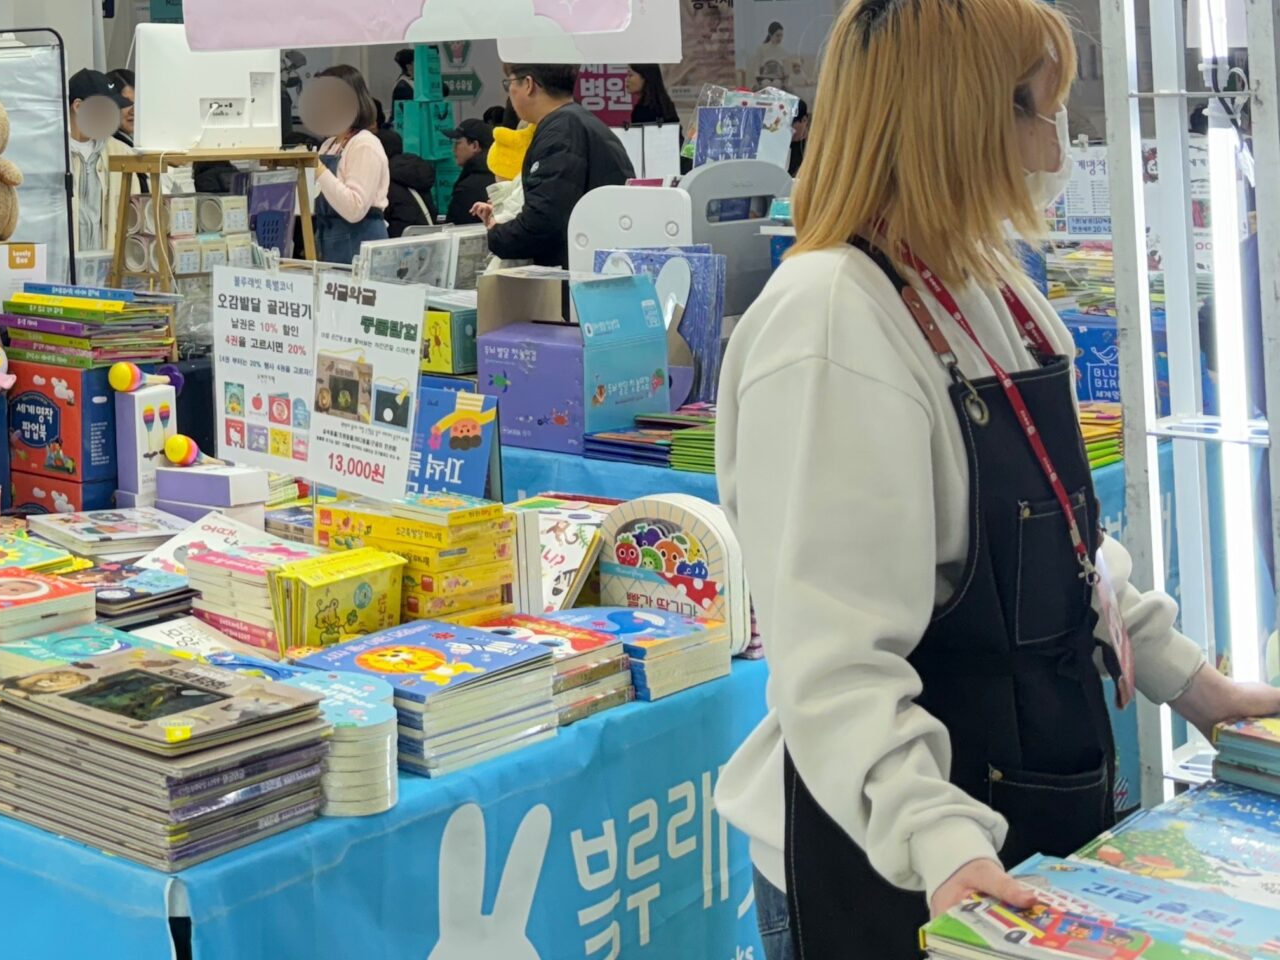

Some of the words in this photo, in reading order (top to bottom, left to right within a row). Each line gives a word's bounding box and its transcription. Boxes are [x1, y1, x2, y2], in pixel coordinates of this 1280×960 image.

[580, 77, 634, 112] 병원
[217, 293, 261, 313] 오감발달
[267, 299, 312, 320] 골라담기
[324, 282, 376, 307] 와글와글
[260, 322, 278, 334] 10%
[282, 324, 299, 337] 할인
[225, 334, 246, 348] 4권을
[251, 337, 284, 353] 고르시면
[288, 343, 307, 356] 20%
[22, 421, 47, 441] 팝업북
[328, 452, 386, 484] 13,000원
